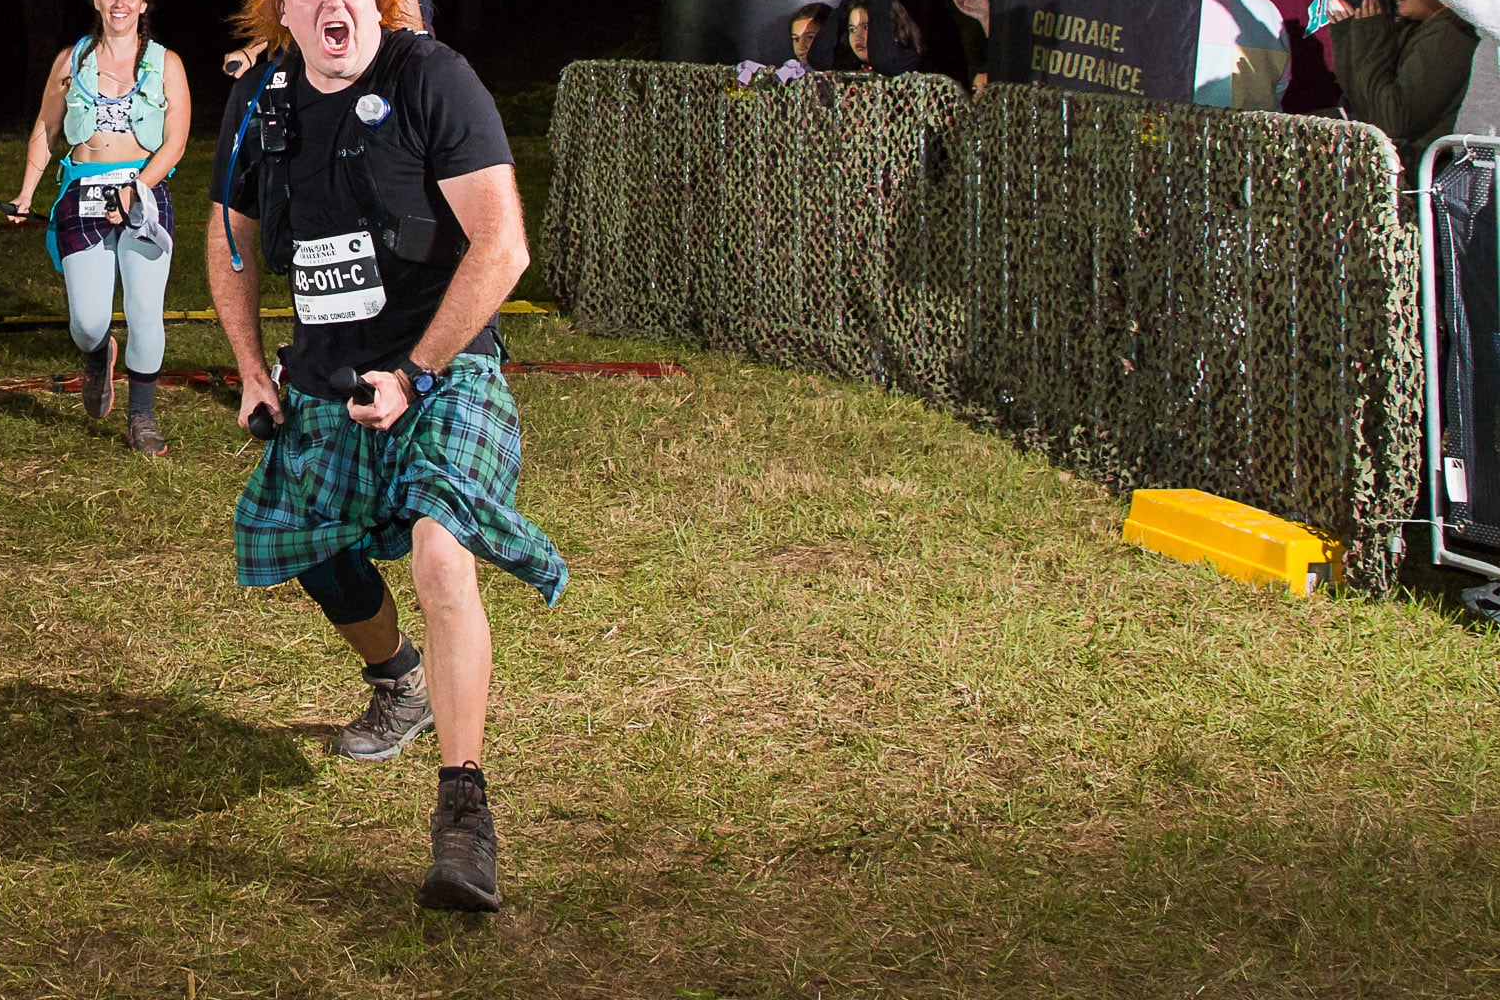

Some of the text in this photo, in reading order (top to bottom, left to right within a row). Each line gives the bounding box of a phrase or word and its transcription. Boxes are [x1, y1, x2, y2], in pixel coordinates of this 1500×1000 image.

[1032, 10, 1125, 53] COURAGE.
[1031, 45, 1145, 96] ENDURANCE.
[295, 264, 365, 291] 48-011-C
